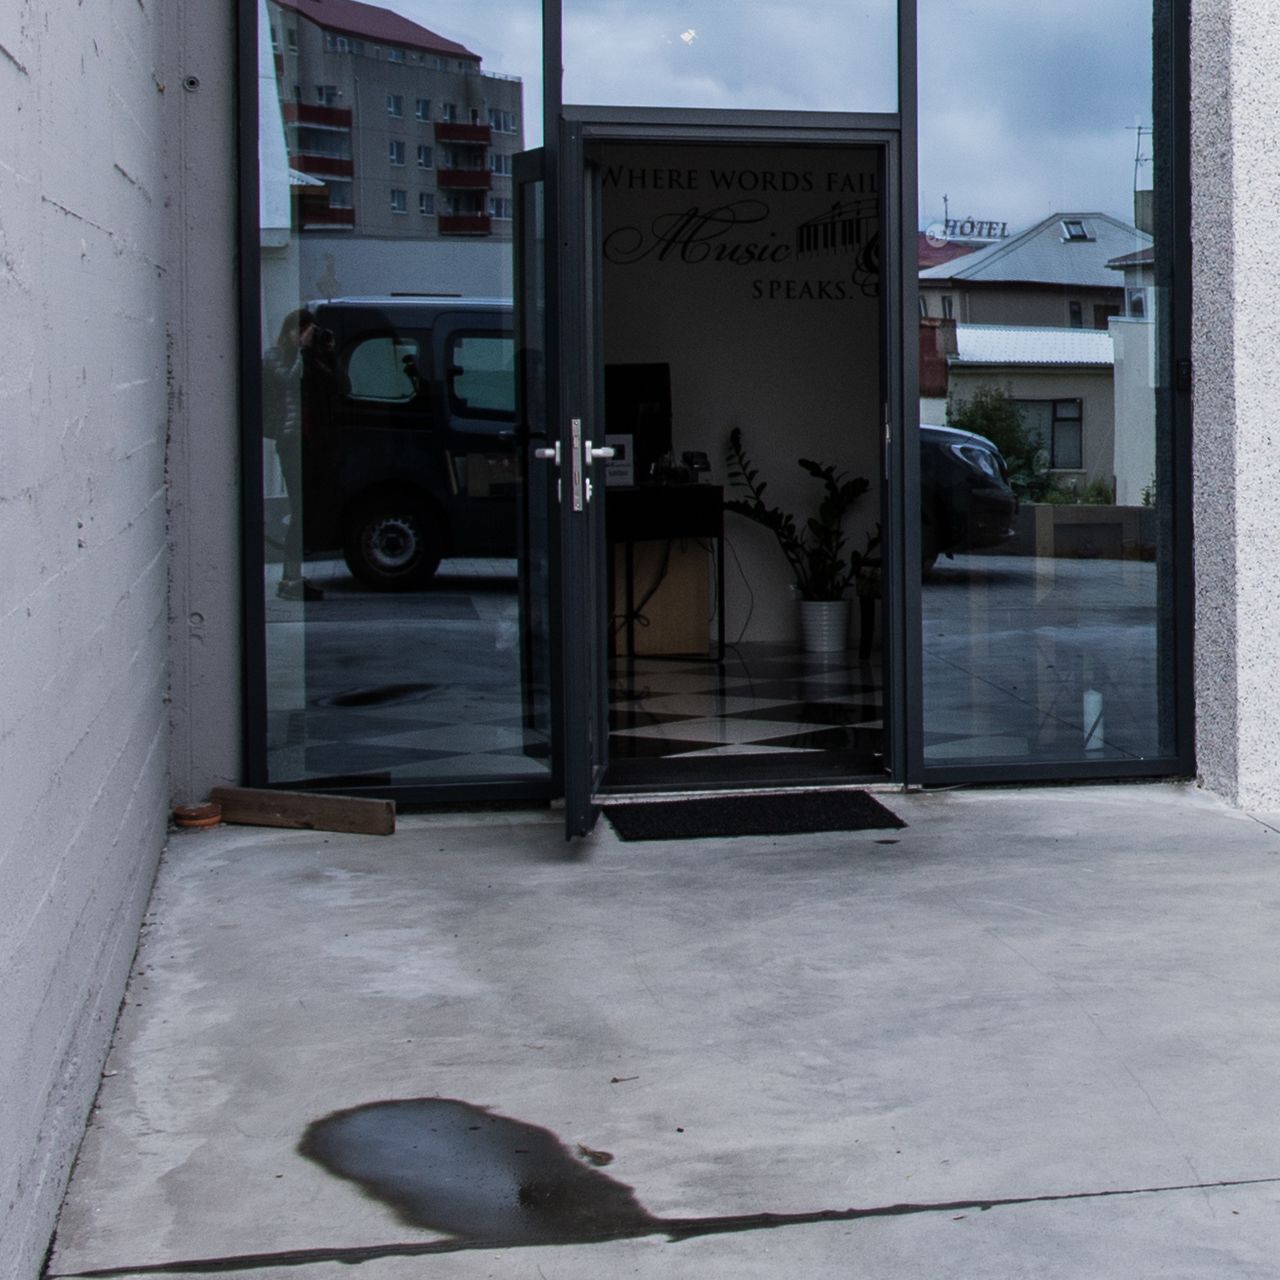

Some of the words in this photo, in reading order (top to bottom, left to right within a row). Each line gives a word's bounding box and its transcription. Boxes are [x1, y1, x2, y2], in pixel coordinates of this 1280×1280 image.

[602, 165, 699, 190] WHERE
[711, 169, 814, 192] WORDS
[603, 199, 792, 265] Music
[752, 279, 854, 300] SPEAKS.
